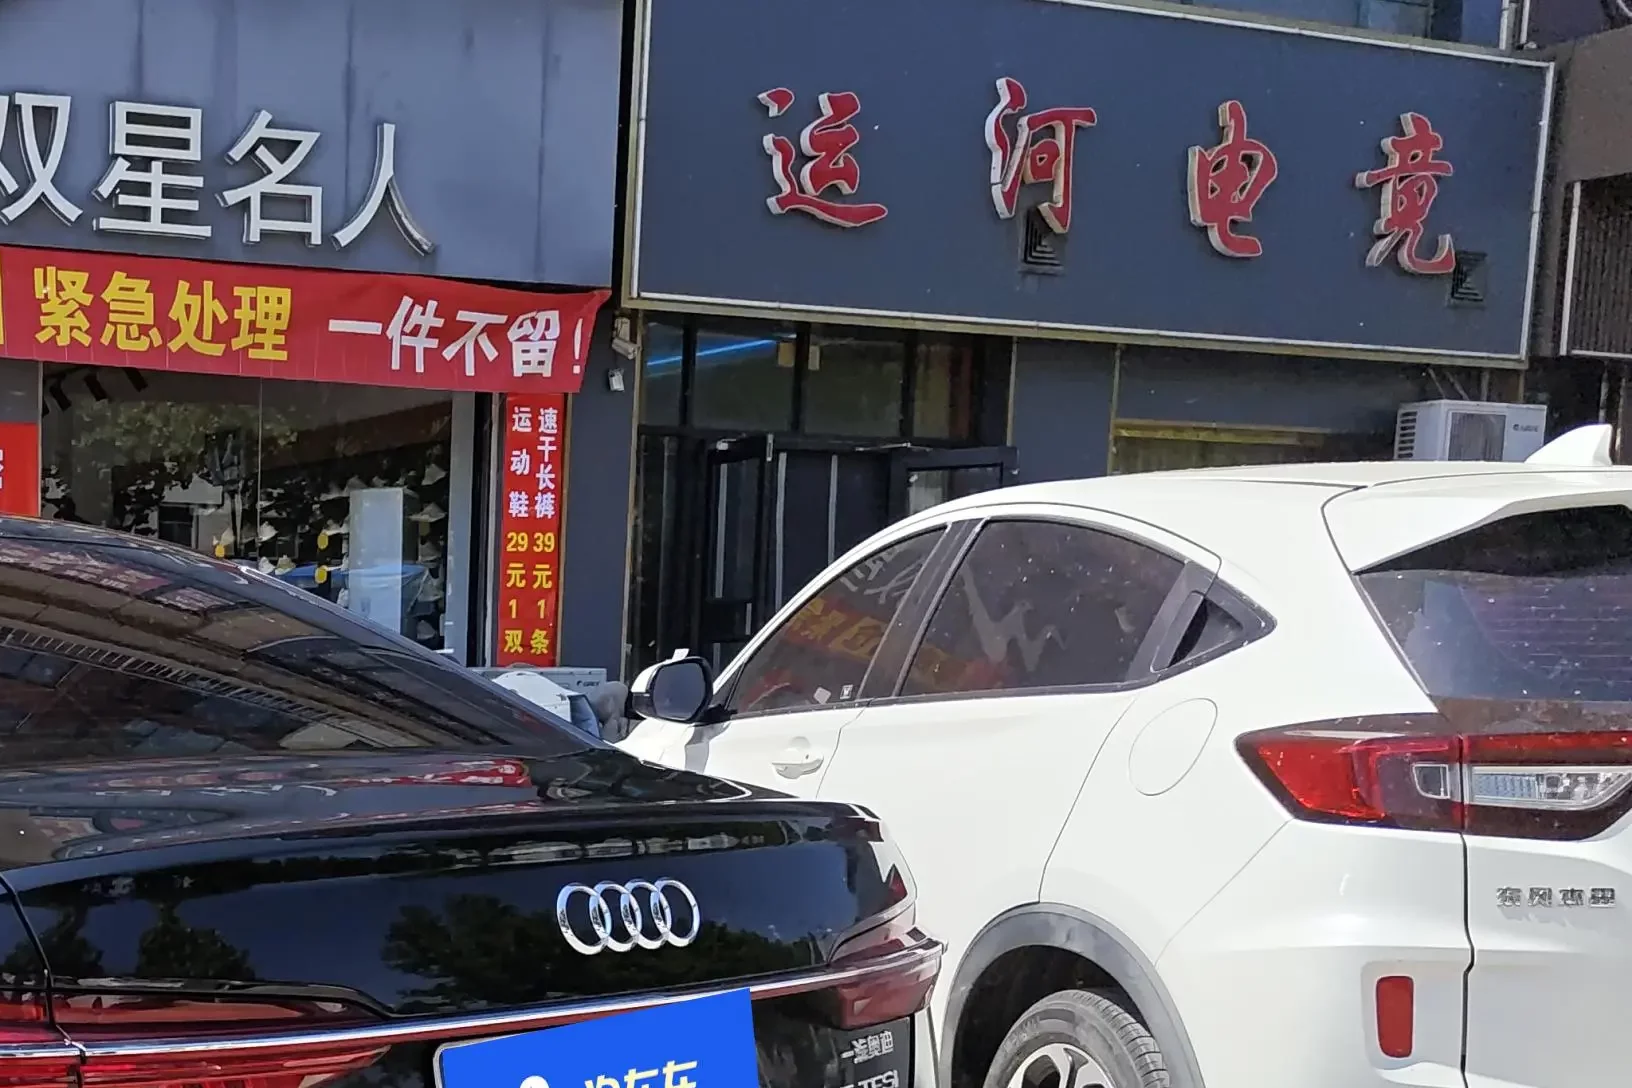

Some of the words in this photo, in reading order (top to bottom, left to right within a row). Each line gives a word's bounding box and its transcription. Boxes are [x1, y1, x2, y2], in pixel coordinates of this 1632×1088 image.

[33, 265, 292, 362] 紧急处理
[328, 295, 584, 377] 一件不留!
